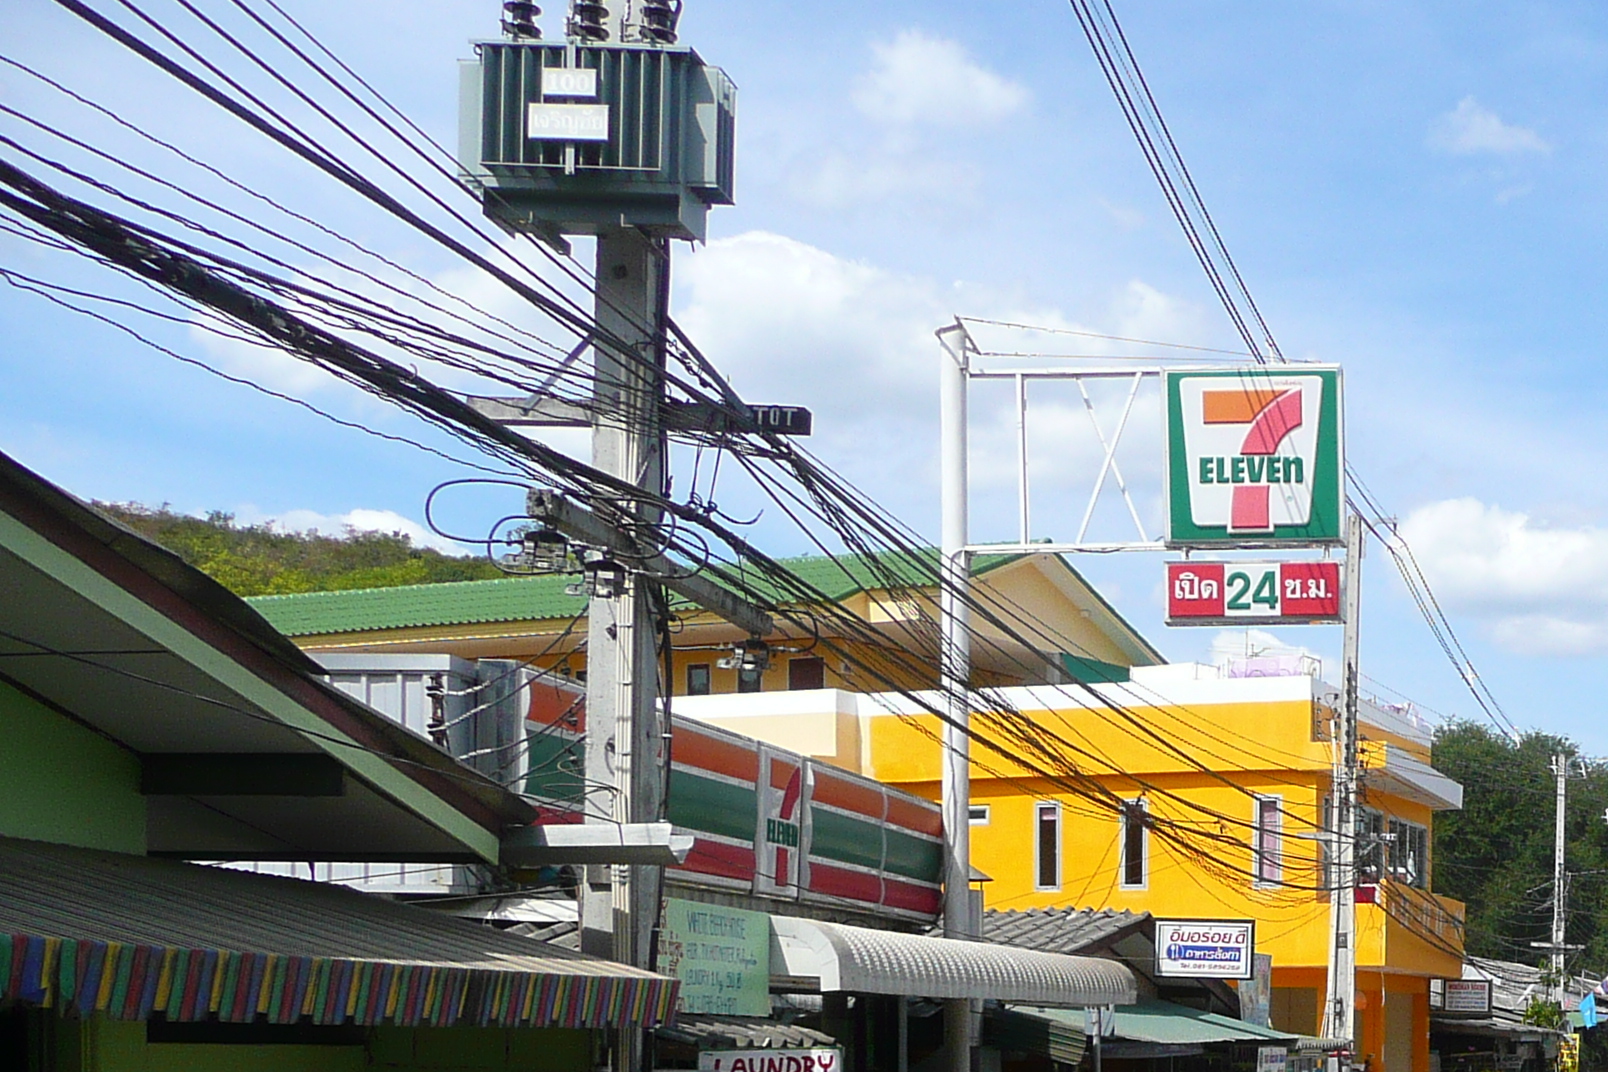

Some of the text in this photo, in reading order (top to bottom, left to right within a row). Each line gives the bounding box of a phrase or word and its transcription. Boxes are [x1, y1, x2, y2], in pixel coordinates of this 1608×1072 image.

[548, 74, 590, 91] 100
[753, 407, 797, 426] TOT
[1203, 388, 1303, 529] 7
[1174, 571, 1333, 611] เปิด 24 ช.ม.
[770, 757, 802, 887] 7
